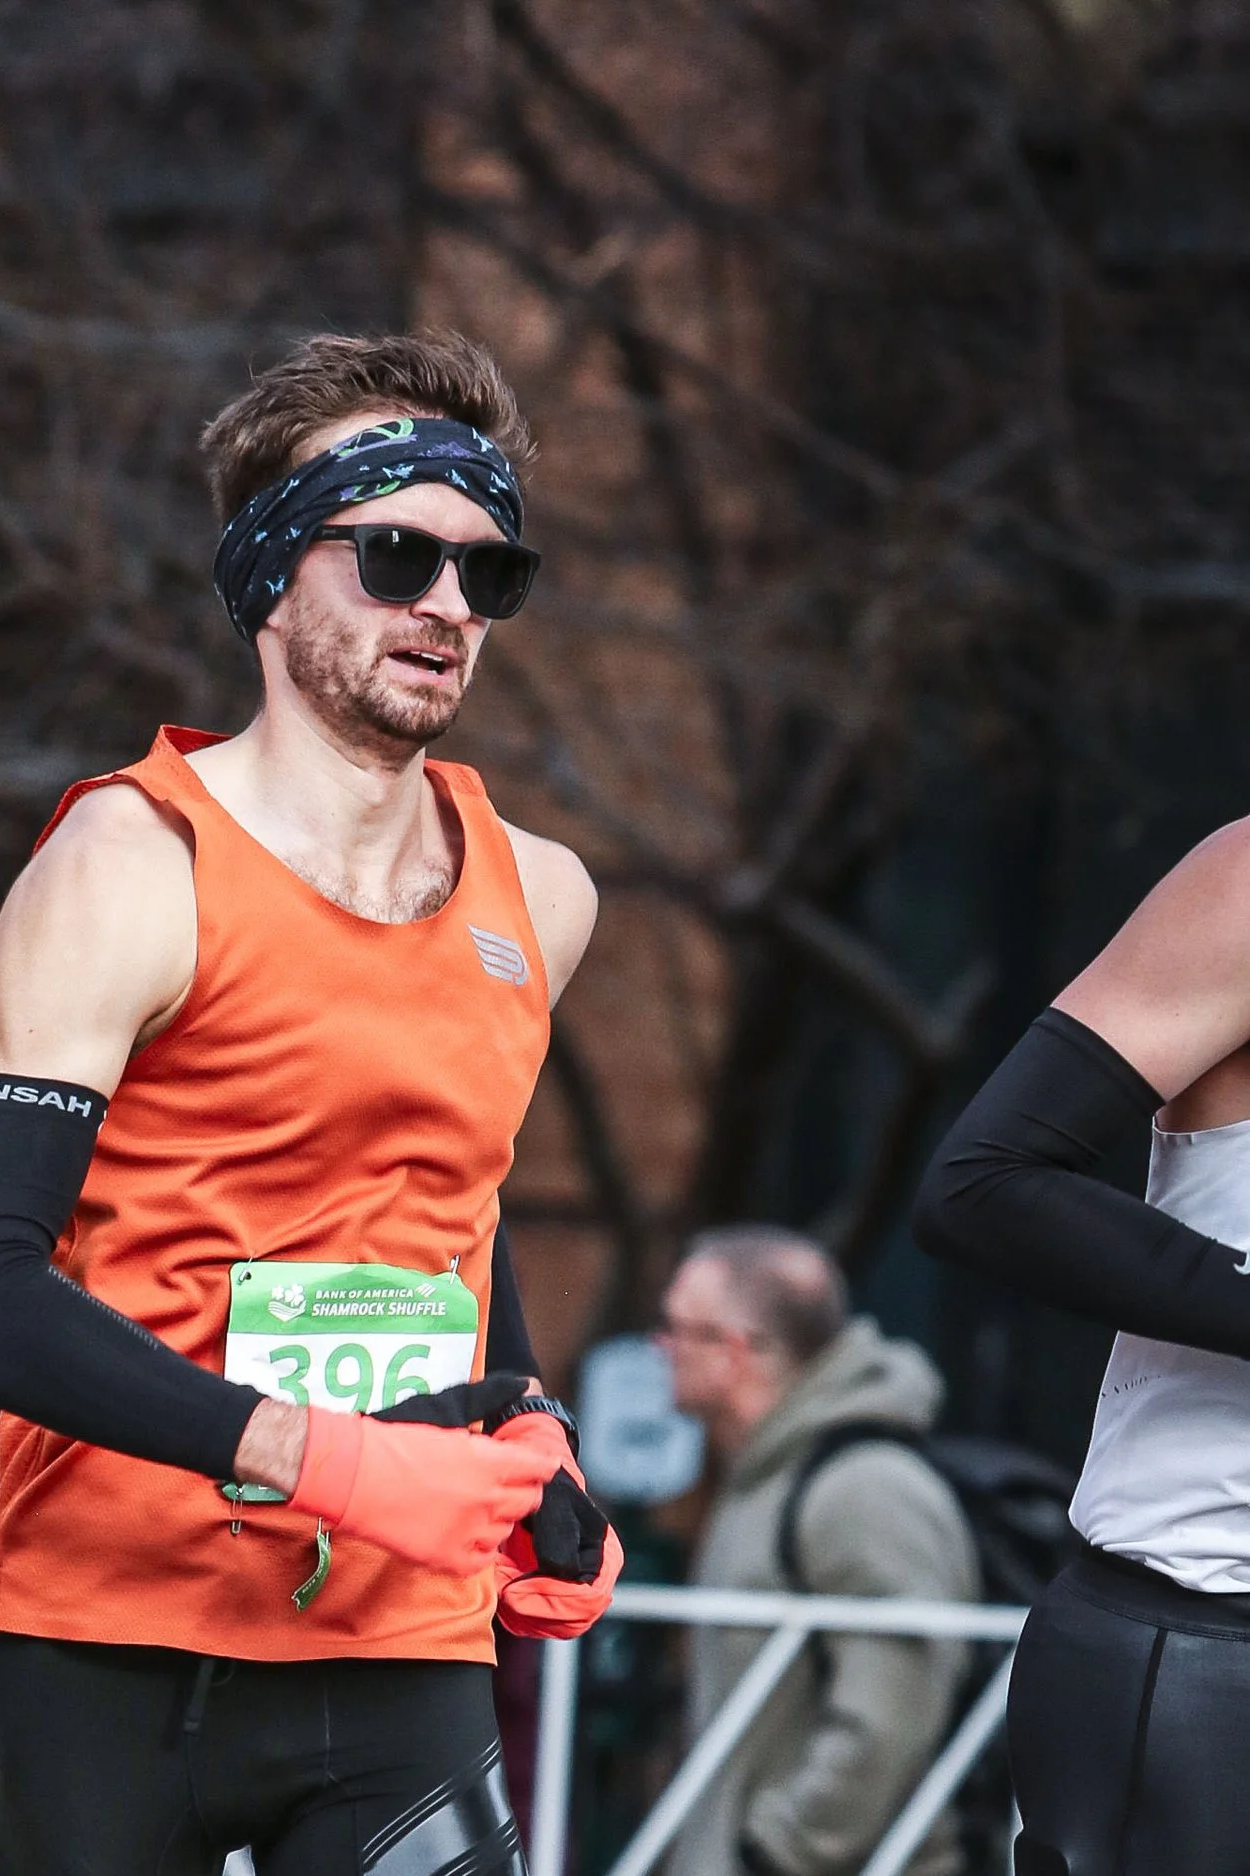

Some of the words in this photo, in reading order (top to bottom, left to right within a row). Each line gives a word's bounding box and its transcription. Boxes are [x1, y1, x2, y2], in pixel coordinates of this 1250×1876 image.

[315, 1289, 347, 1300] BANK
[348, 1289, 362, 1300] OF
[363, 1288, 414, 1299] AMERICA
[311, 1302, 386, 1317] SHAMROCK
[387, 1301, 447, 1316] SHUFFLE
[269, 1343, 432, 1413] 396
